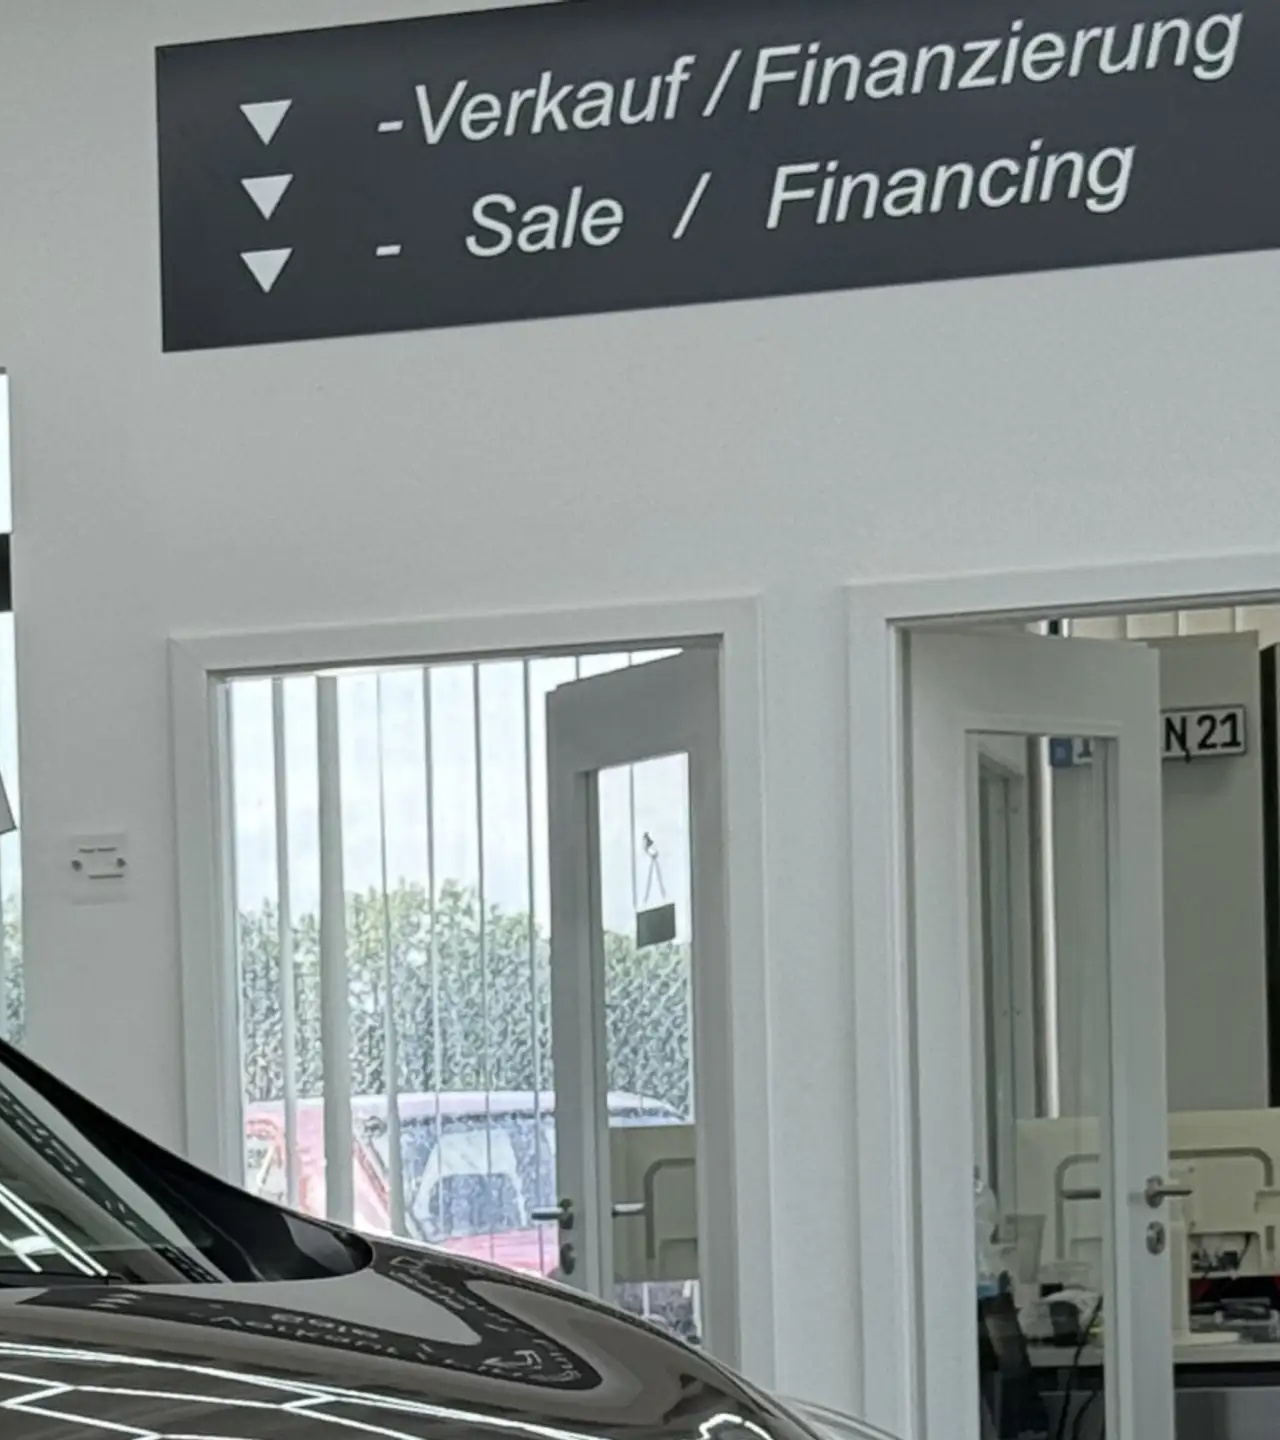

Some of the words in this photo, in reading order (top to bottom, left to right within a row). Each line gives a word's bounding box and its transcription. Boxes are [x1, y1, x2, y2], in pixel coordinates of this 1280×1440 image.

[465, 186, 624, 257] Sale
[766, 138, 1136, 229] Financing
[1196, 711, 1242, 750] 21
